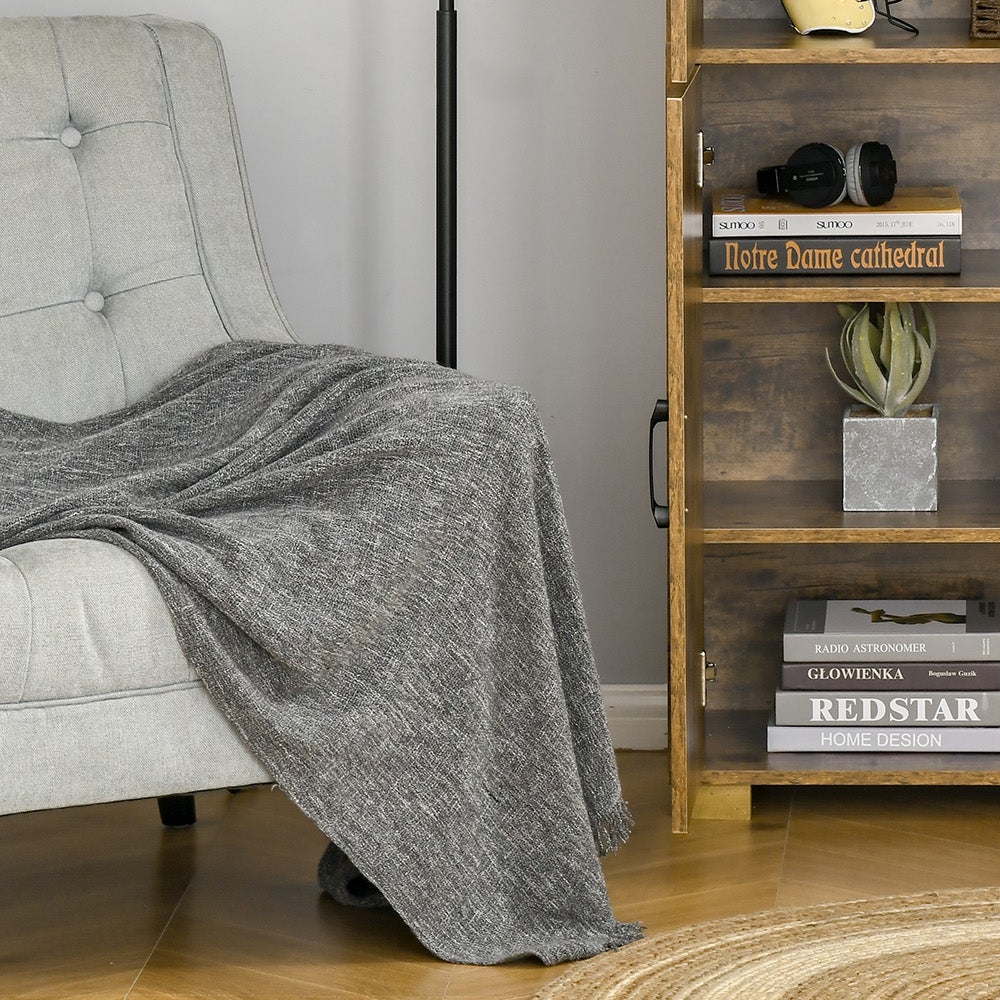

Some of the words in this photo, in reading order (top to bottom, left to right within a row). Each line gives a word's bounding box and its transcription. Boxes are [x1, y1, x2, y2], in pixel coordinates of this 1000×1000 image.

[724, 242, 779, 271] Notre
[785, 239, 844, 270] Dame
[851, 239, 946, 269] cathedral
[814, 643, 849, 654] RADIO
[853, 642, 927, 654] ASTRONOMER
[820, 732, 872, 747] HOME
[877, 733, 943, 748] DESION
